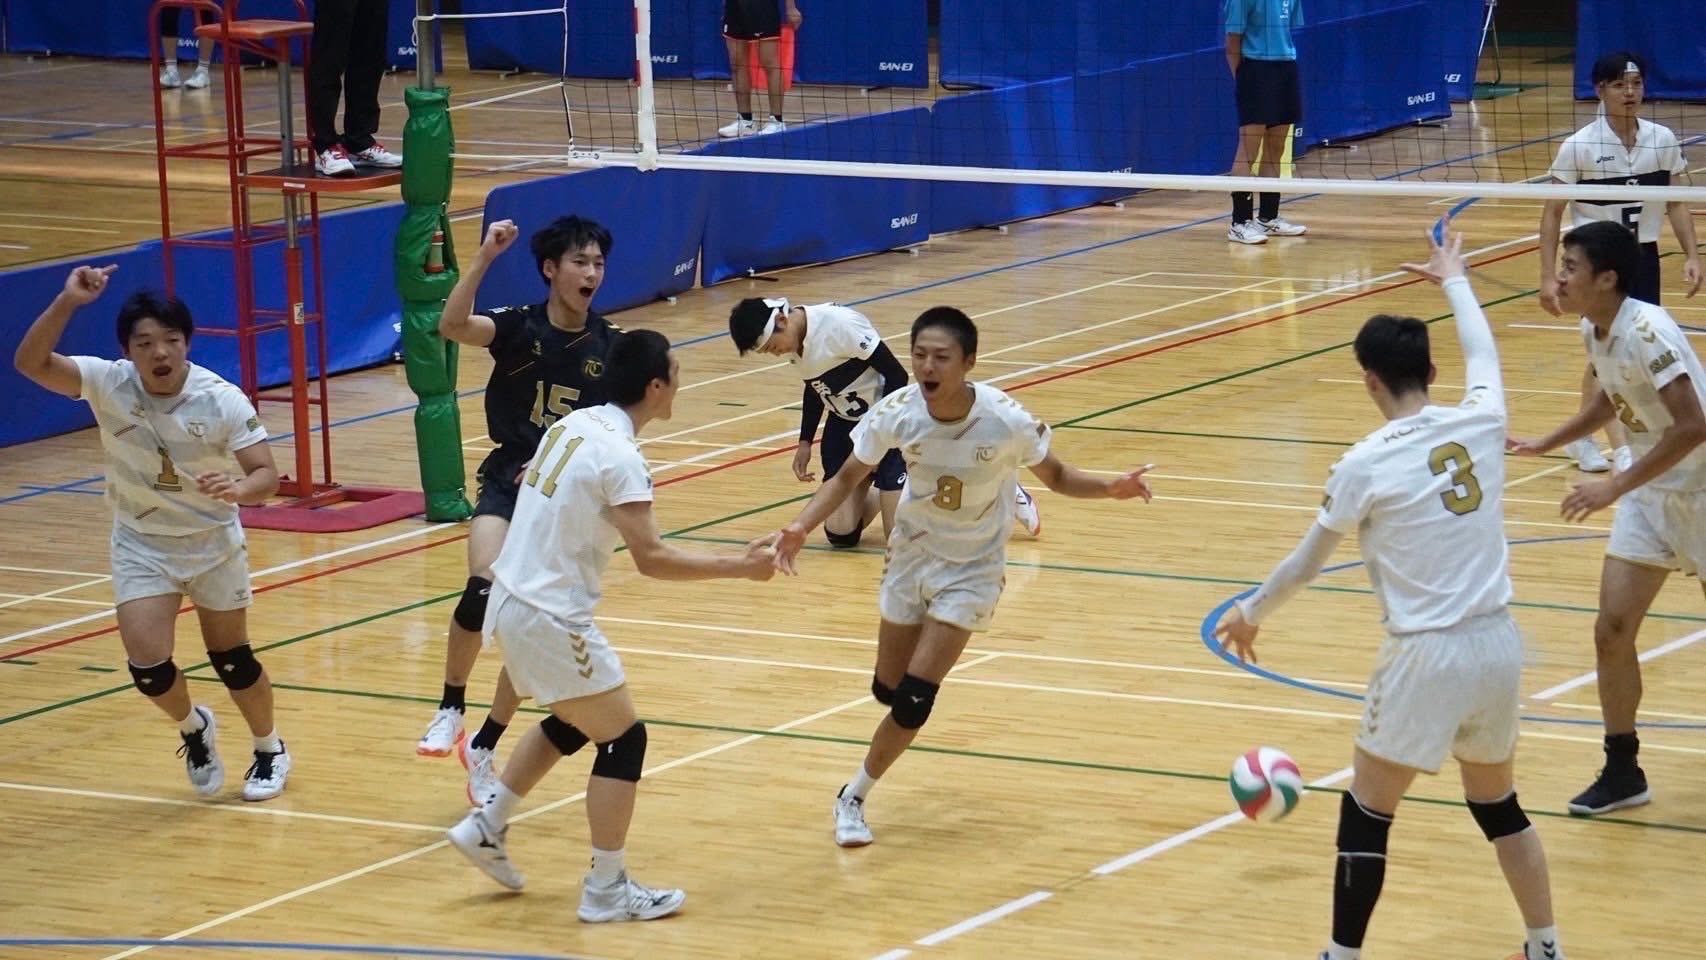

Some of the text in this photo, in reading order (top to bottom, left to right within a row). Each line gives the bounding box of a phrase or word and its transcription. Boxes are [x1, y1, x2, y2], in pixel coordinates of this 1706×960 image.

[879, 62, 914, 71] SAN-EI
[1407, 92, 1435, 105] SAN-EI
[530, 381, 581, 430] 15
[1612, 393, 1649, 433] 2
[154, 446, 182, 492] 1
[527, 423, 585, 498] 11
[1428, 442, 1482, 515] 3
[935, 476, 962, 512] 8
